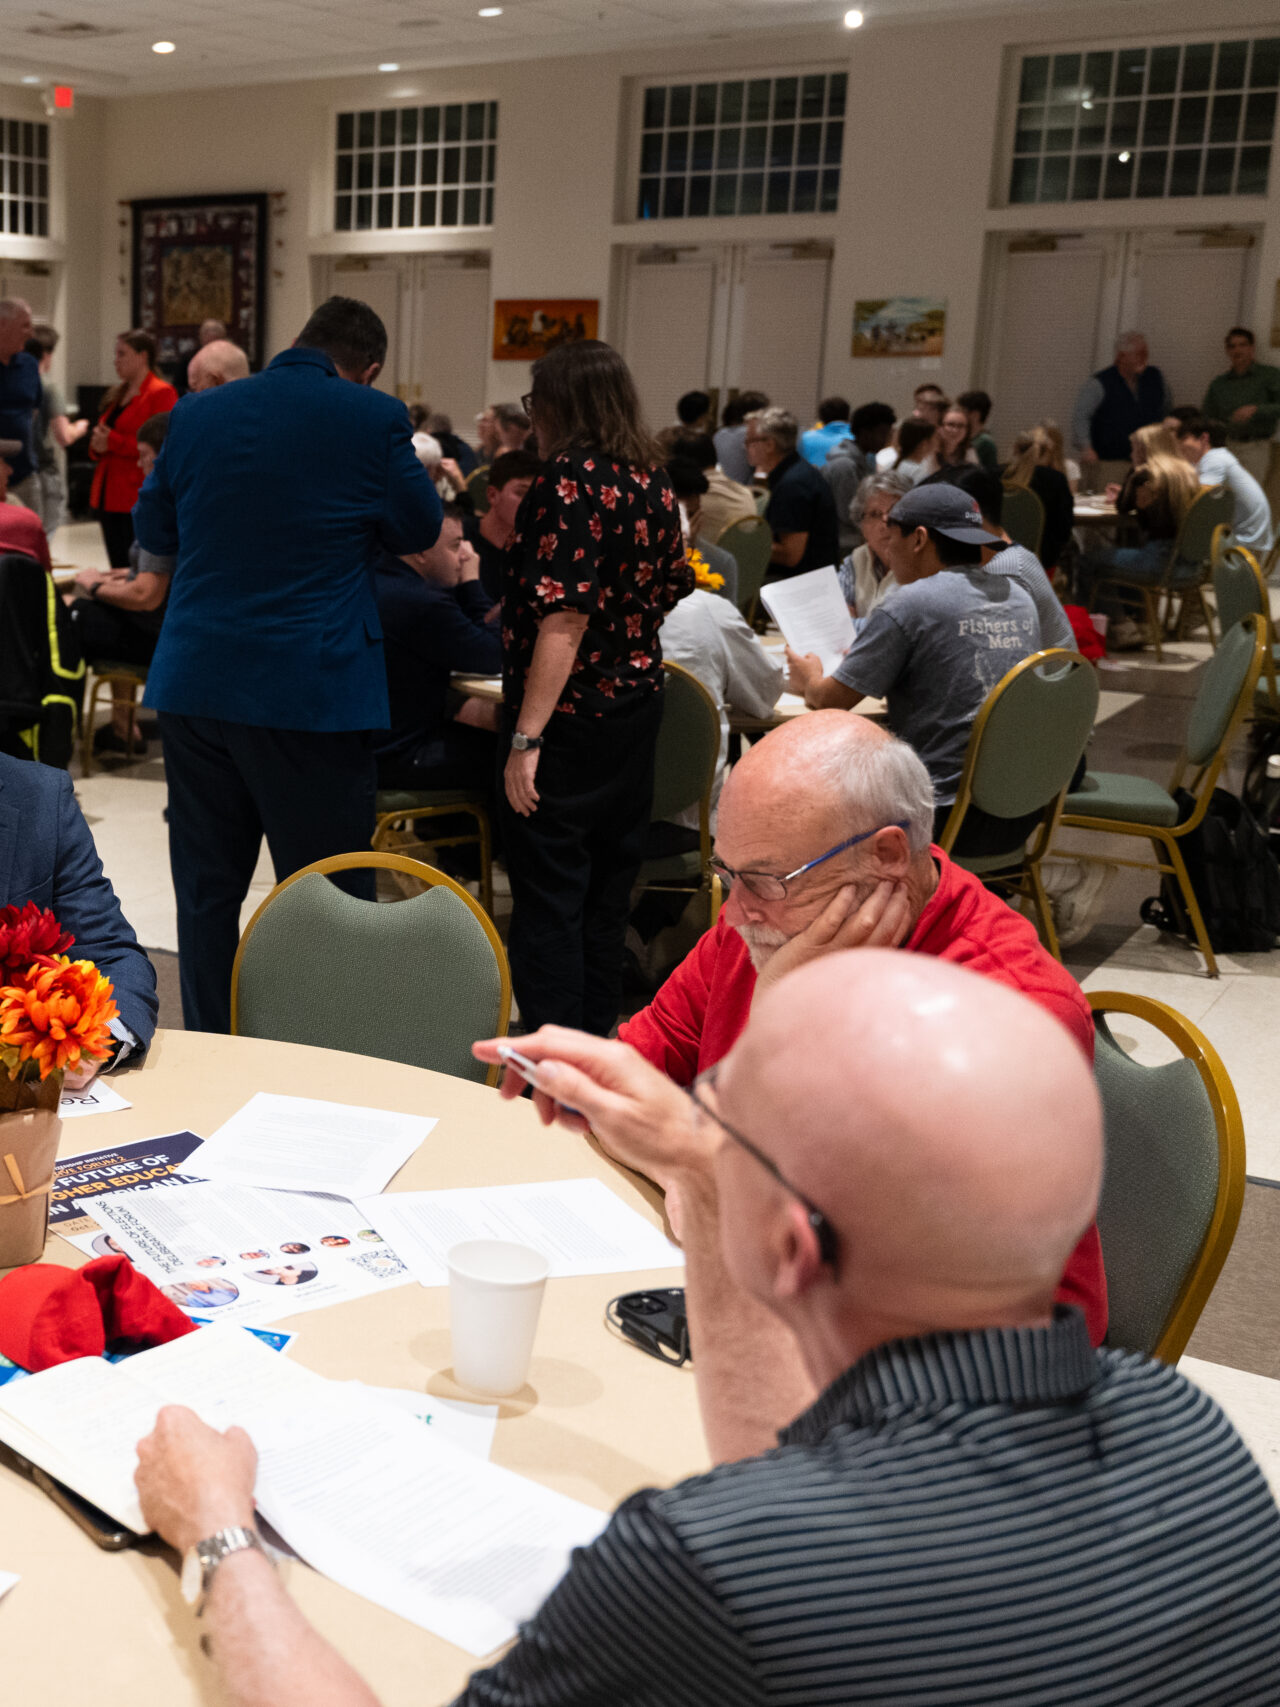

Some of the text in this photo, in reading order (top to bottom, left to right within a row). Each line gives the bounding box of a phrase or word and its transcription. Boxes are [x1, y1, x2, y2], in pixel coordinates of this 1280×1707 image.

[958, 616, 1034, 636] Fishers of
[987, 635, 1023, 649] Men
[76, 1158, 117, 1171] FORUM
[117, 1155, 126, 1163] 2
[84, 1152, 119, 1163] INITIATIVE
[57, 1154, 170, 1187] FUTURE OF
[50, 1181, 111, 1202] GHER
[95, 1200, 131, 1230] ELECTIONS
[125, 1230, 141, 1239] OF
[134, 1239, 162, 1262] FUTURE
[135, 1225, 184, 1266] DELIBERATIVE
